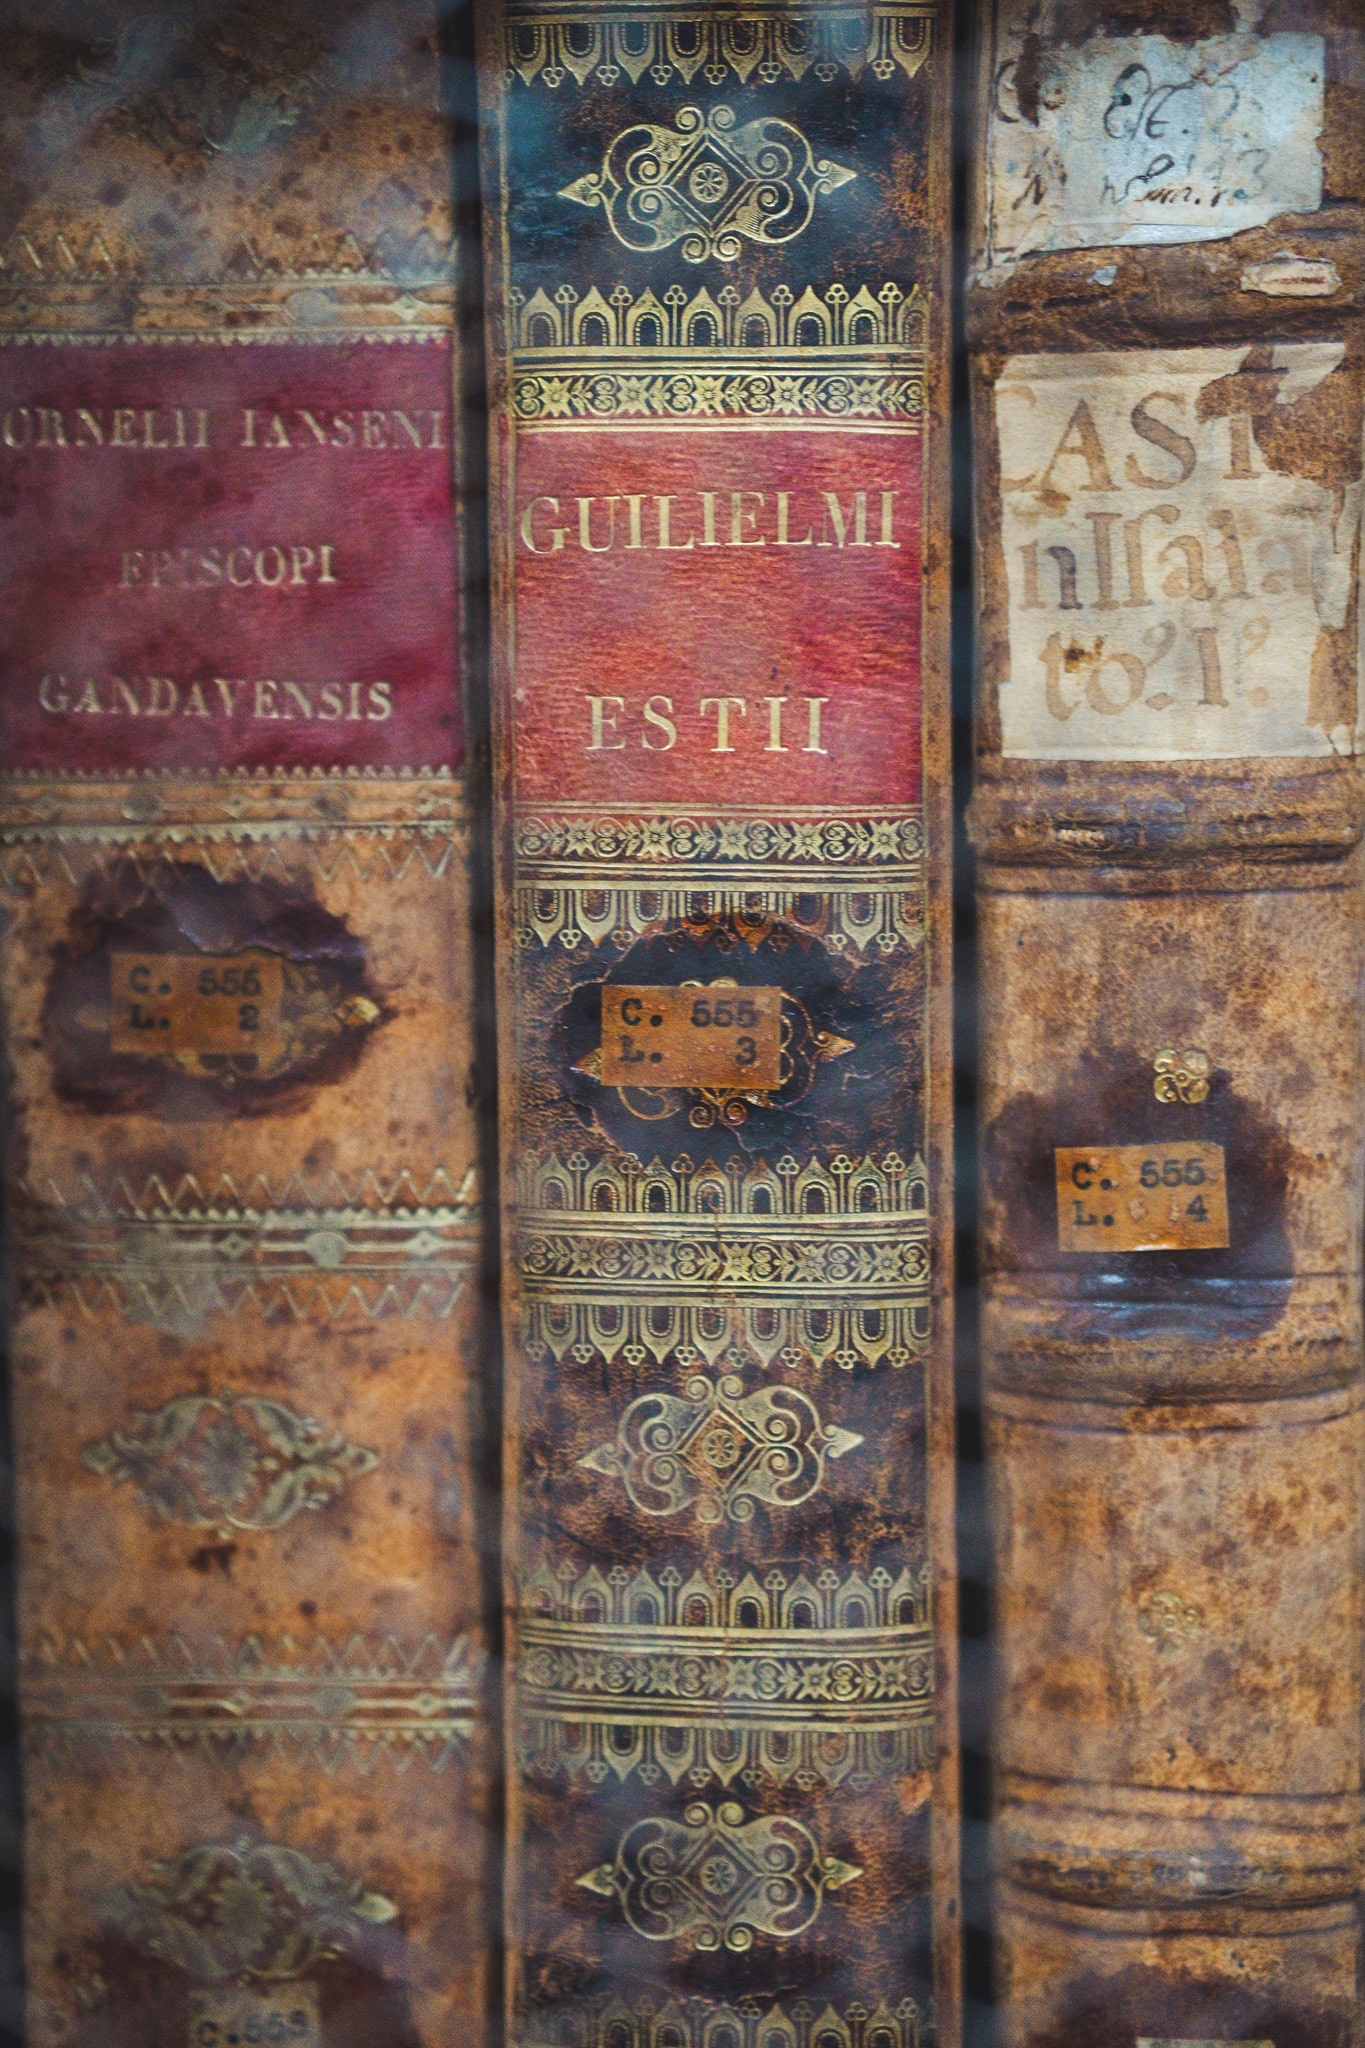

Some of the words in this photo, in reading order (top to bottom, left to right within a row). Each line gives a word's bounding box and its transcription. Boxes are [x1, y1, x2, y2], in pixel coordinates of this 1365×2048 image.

[520, 490, 901, 555] GUILIELMI
[118, 545, 339, 588] EPISCOPI
[38, 673, 393, 722] GANDAVENSIS
[128, 966, 173, 996] C.
[127, 1003, 172, 1031] L.
[238, 1004, 260, 1032] 2
[620, 997, 663, 1028] C.
[690, 998, 758, 1028] 555
[618, 1034, 663, 1064] L.
[735, 1035, 757, 1066] 3
[1071, 1161, 1112, 1190] C.
[1072, 1200, 1116, 1227] L.
[1186, 1195, 1210, 1223] 4
